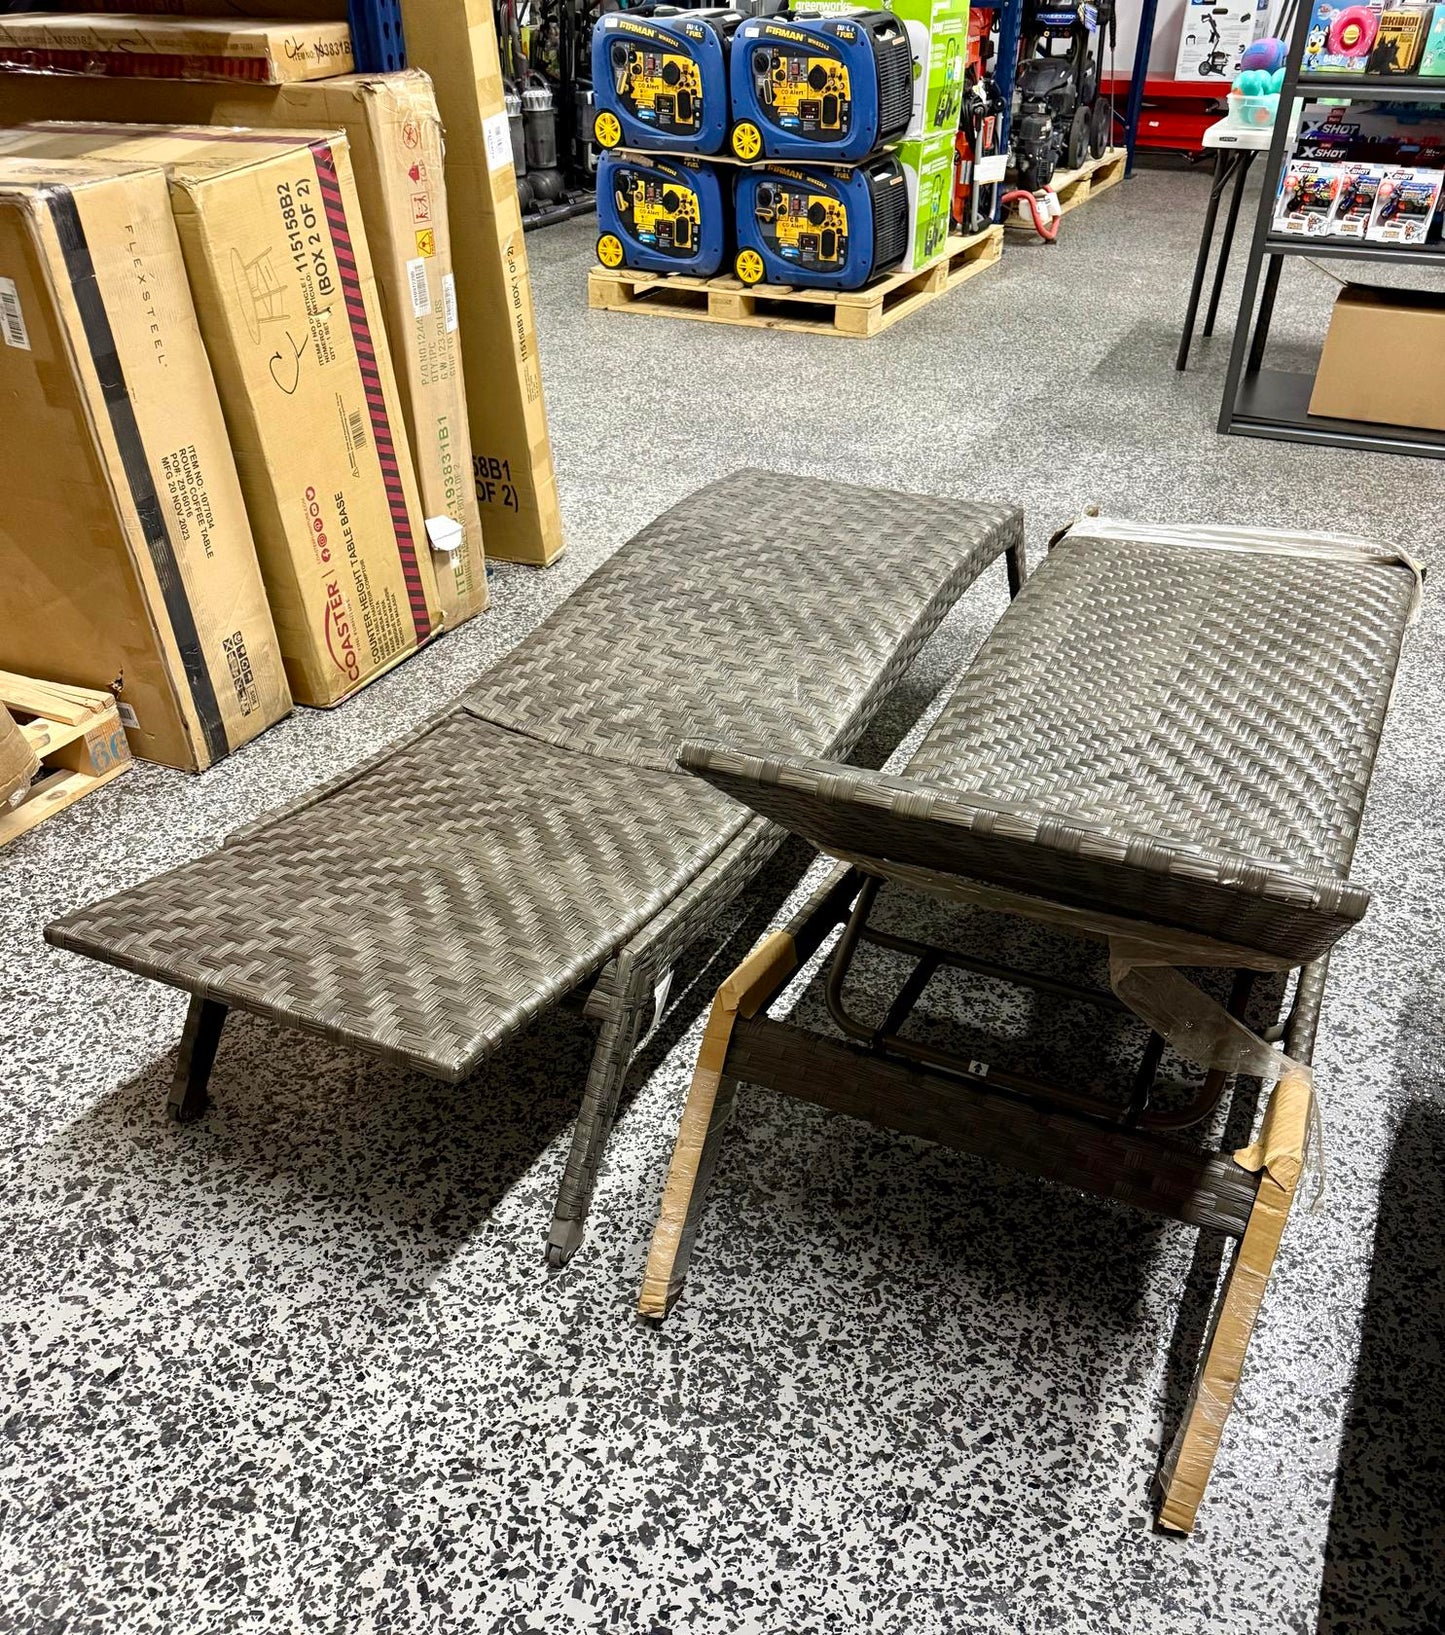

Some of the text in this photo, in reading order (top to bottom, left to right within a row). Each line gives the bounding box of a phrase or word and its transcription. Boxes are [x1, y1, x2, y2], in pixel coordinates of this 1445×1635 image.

[619, 20, 655, 37] FIRMAN
[689, 29, 703, 39] FUEL
[766, 25, 804, 42] FIRMAN
[840, 30, 854, 39] FUEL
[1381, 16, 1418, 26] SKIBIDI
[767, 164, 803, 180] FIRMAN
[277, 182, 308, 273] 115158B2
[295, 178, 335, 296] (BOX 2 OF 2)
[508, 260, 516, 274] OF
[161, 456, 190, 541] MFG 20 NOV 2023
[170, 452, 193, 518] PO#: Z916016
[179, 448, 214, 559] ROUND COFFEE TABLE
[188, 444, 215, 529] ITEM NO: 1077034
[502, 484, 519, 514] 2)
[334, 491, 380, 665] COUNTER HEIGHT TABLE BASE
[327, 580, 360, 681] COASTER
